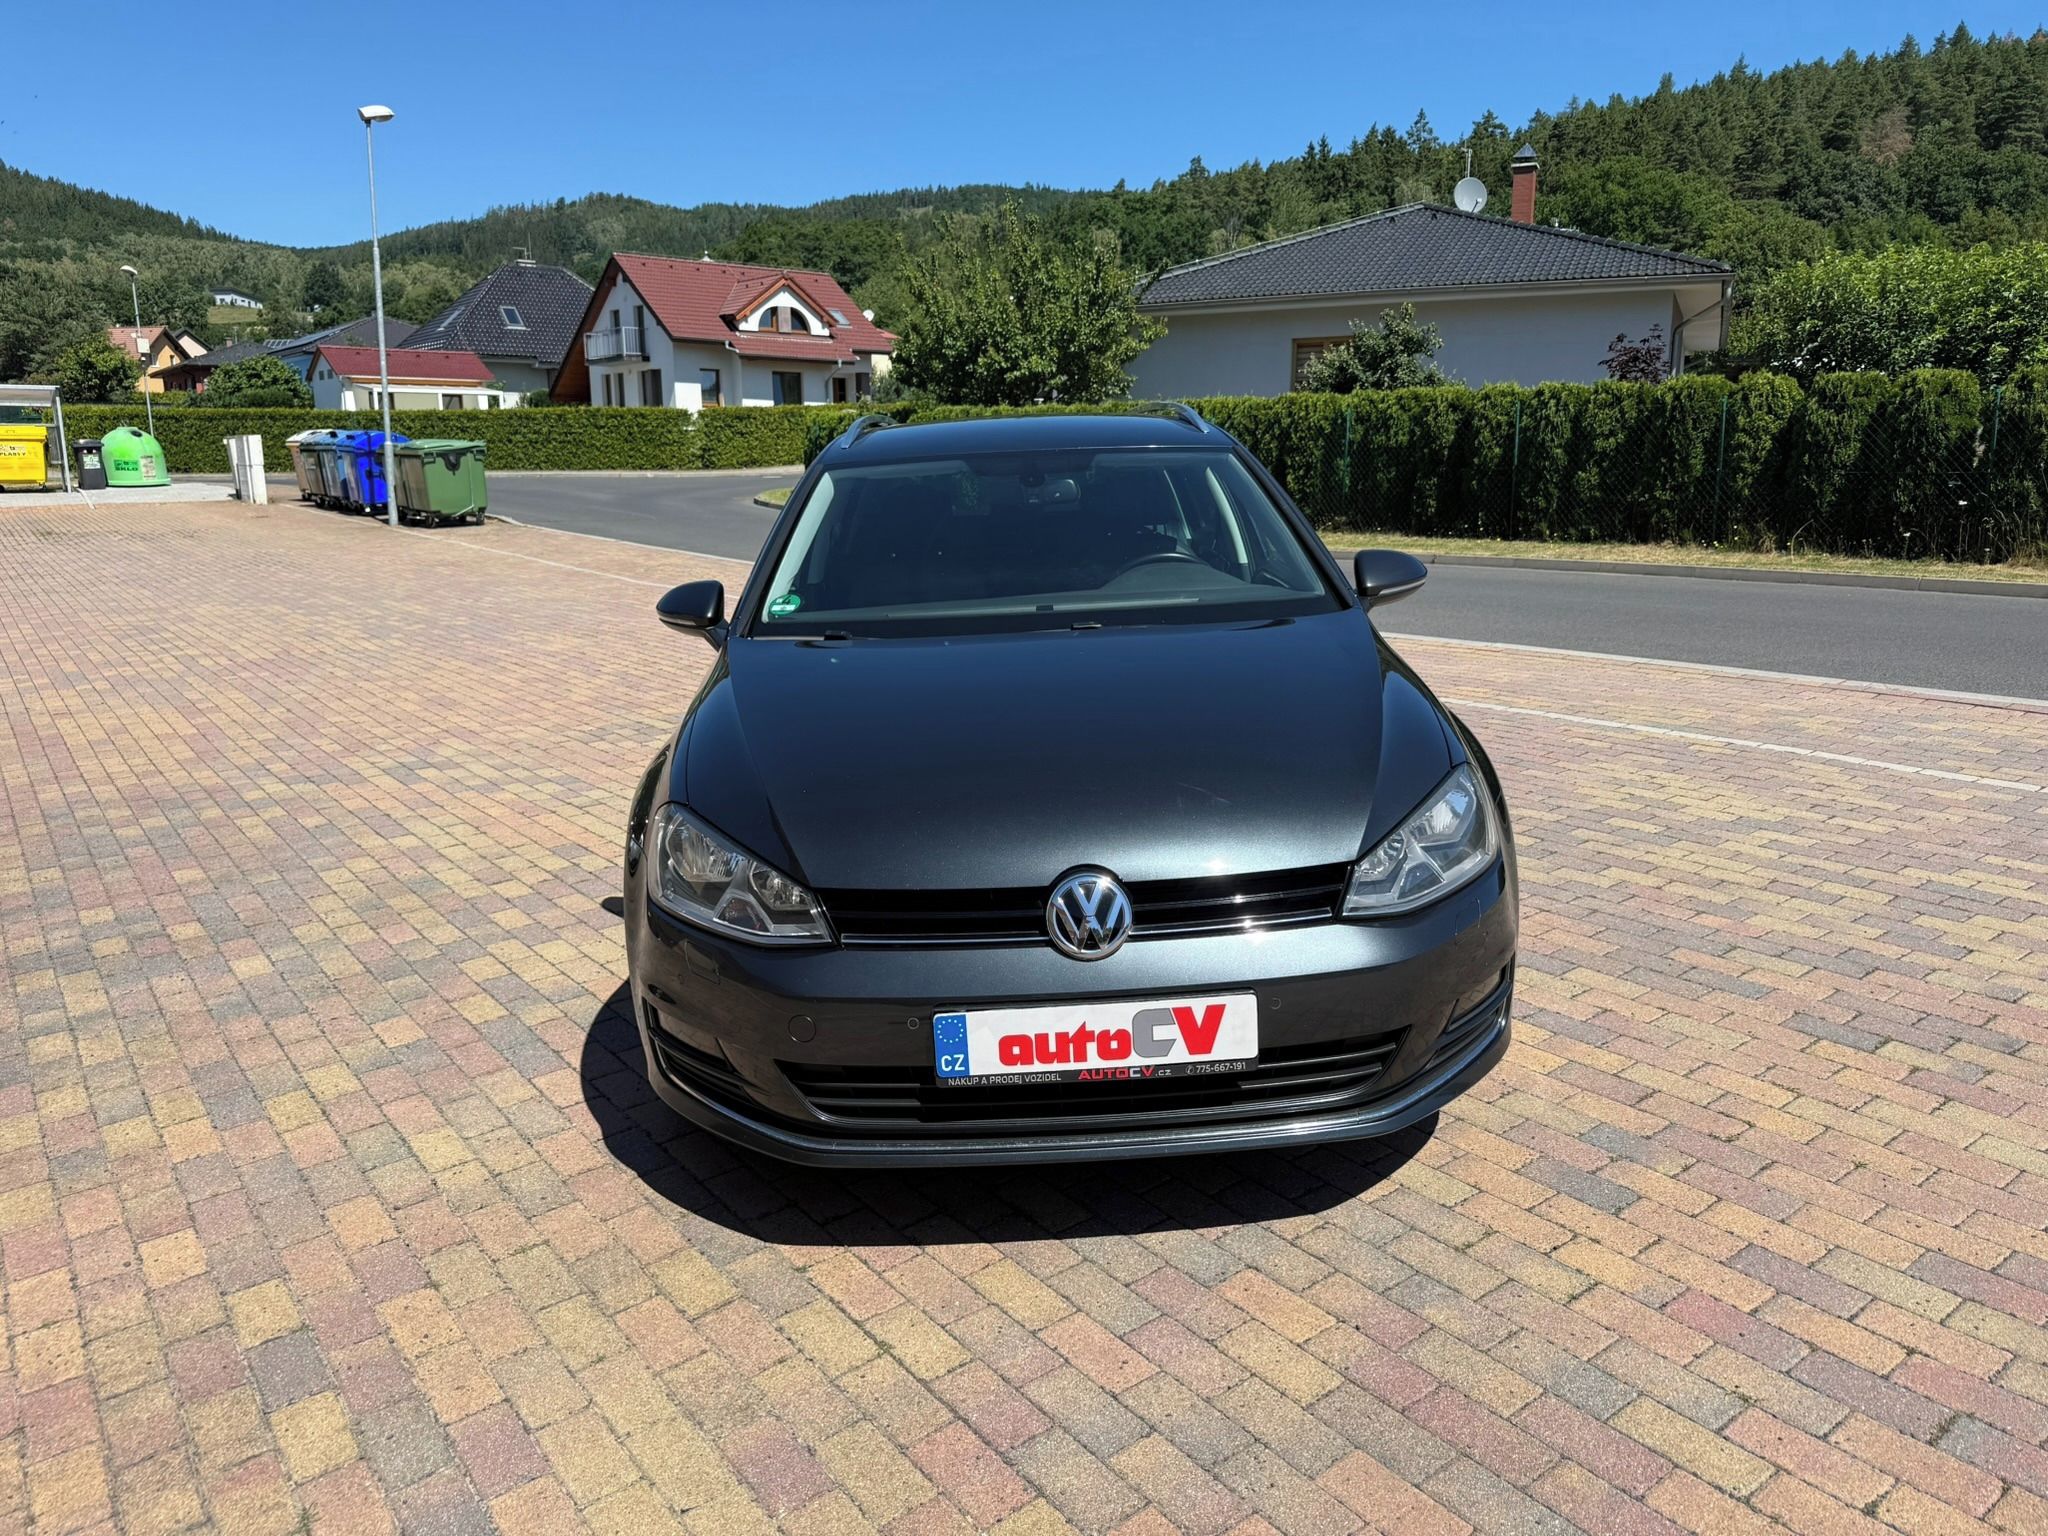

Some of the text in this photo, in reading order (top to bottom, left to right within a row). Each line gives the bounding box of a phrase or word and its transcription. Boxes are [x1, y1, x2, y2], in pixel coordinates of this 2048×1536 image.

[998, 1004, 1227, 1066] autoCV
[941, 1054, 966, 1072] CZ
[981, 1076, 988, 1084] A
[990, 1073, 1022, 1084] PRODEJ
[1025, 1072, 1062, 1082] VOZIDEL
[1078, 1066, 1172, 1080] AUTOCV.cz
